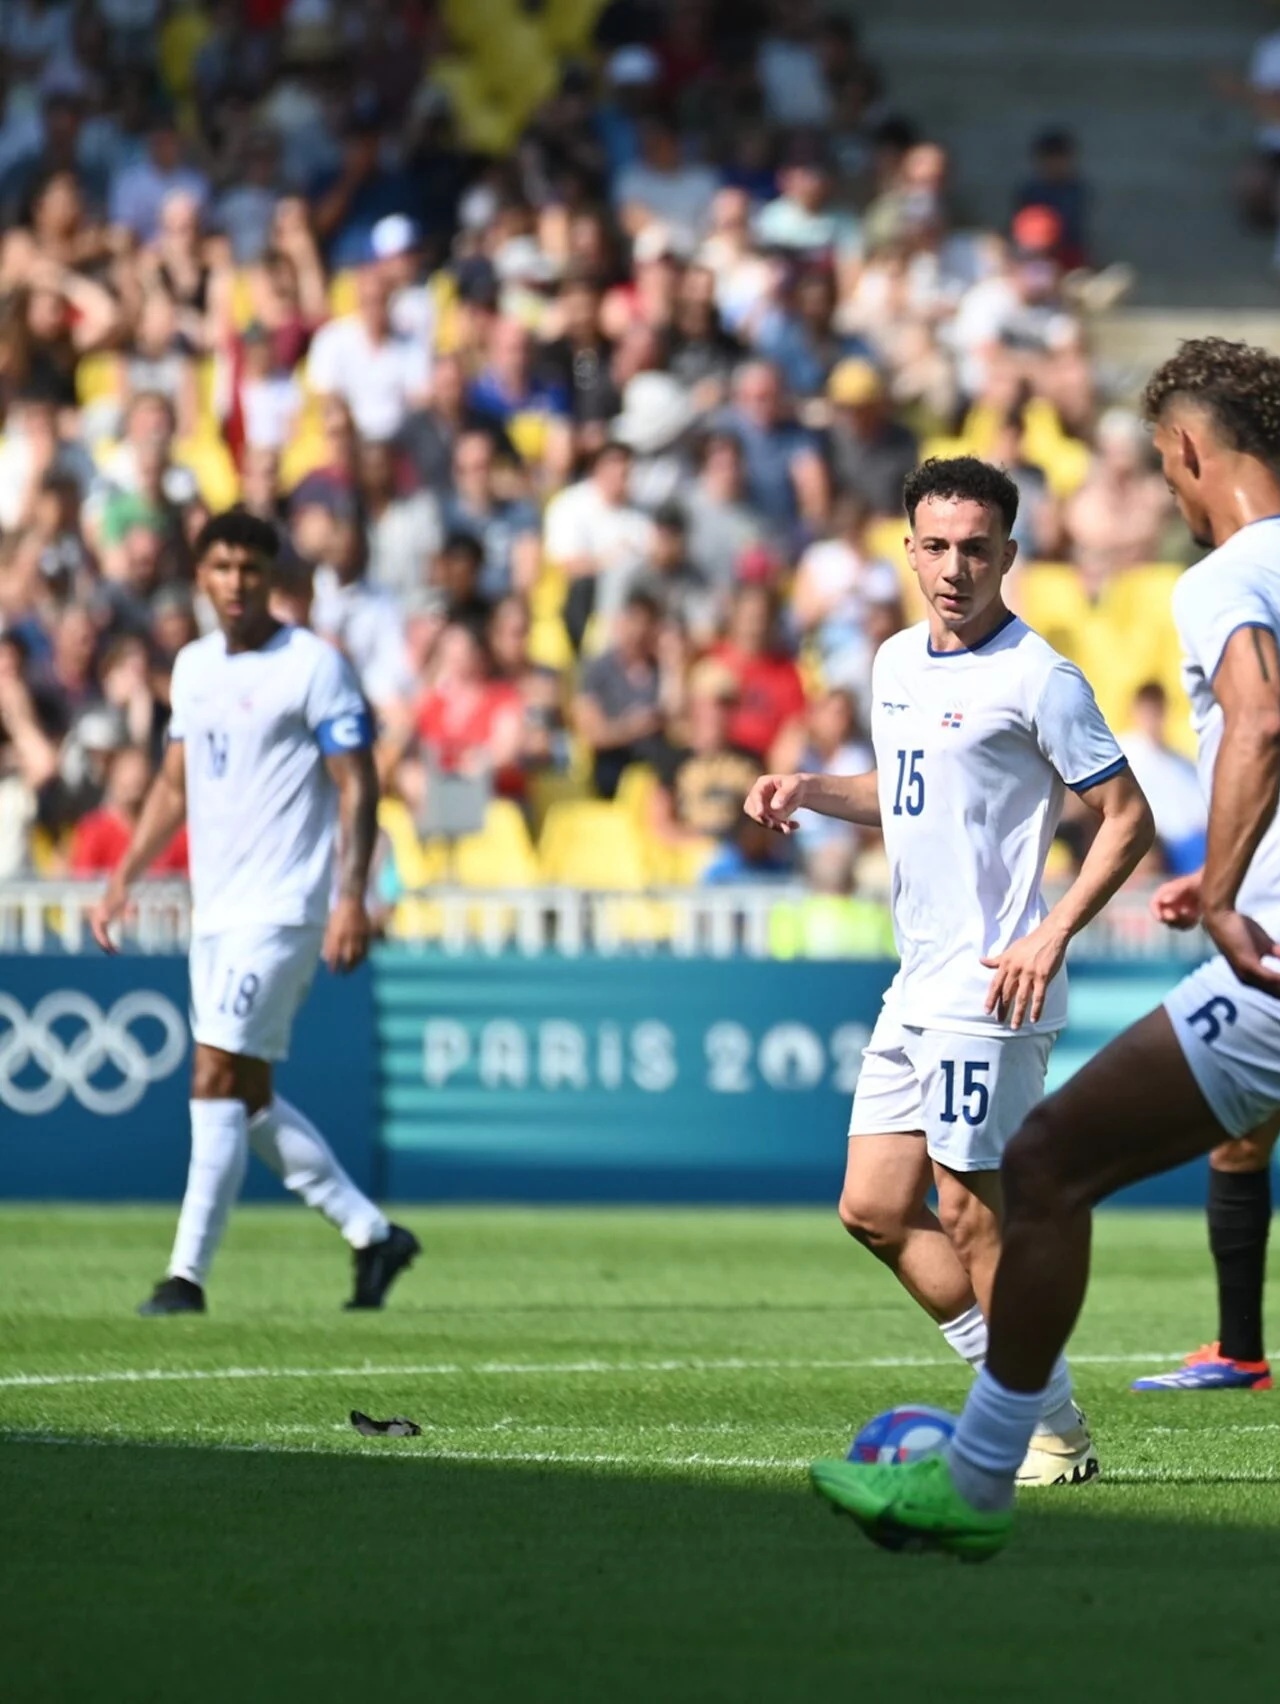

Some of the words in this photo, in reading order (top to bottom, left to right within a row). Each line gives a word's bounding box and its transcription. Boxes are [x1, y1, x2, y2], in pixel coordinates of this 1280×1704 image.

[893, 748, 925, 817] 15
[217, 968, 260, 1020] 18
[1185, 995, 1238, 1046] 6
[423, 1018, 677, 1092] PARIS
[704, 1020, 870, 1092] 202
[939, 1059, 990, 1127] 15
